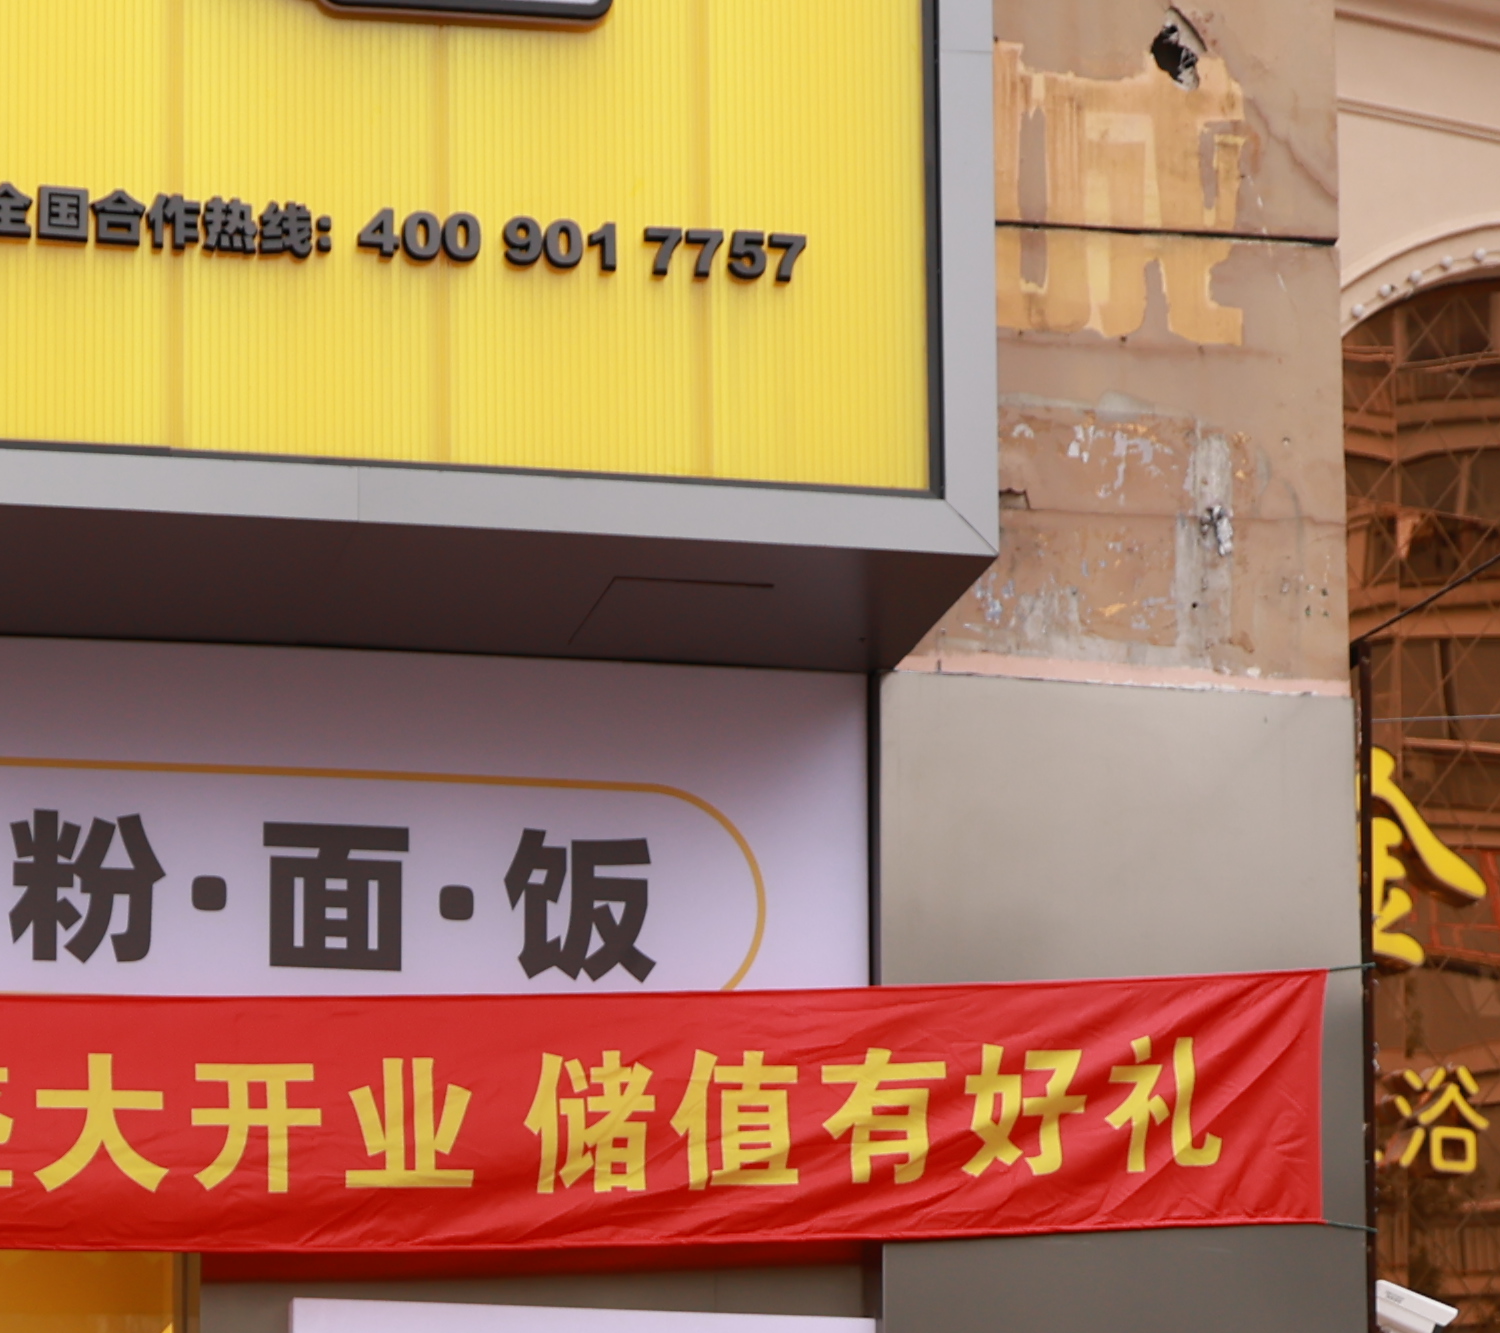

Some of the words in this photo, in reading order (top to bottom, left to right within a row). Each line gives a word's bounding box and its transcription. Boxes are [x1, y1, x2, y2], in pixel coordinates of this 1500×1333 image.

[356, 206, 482, 267] 400
[501, 216, 619, 274] 901
[643, 225, 808, 285] 7757
[524, 1034, 1225, 1196] 储值有好礼
